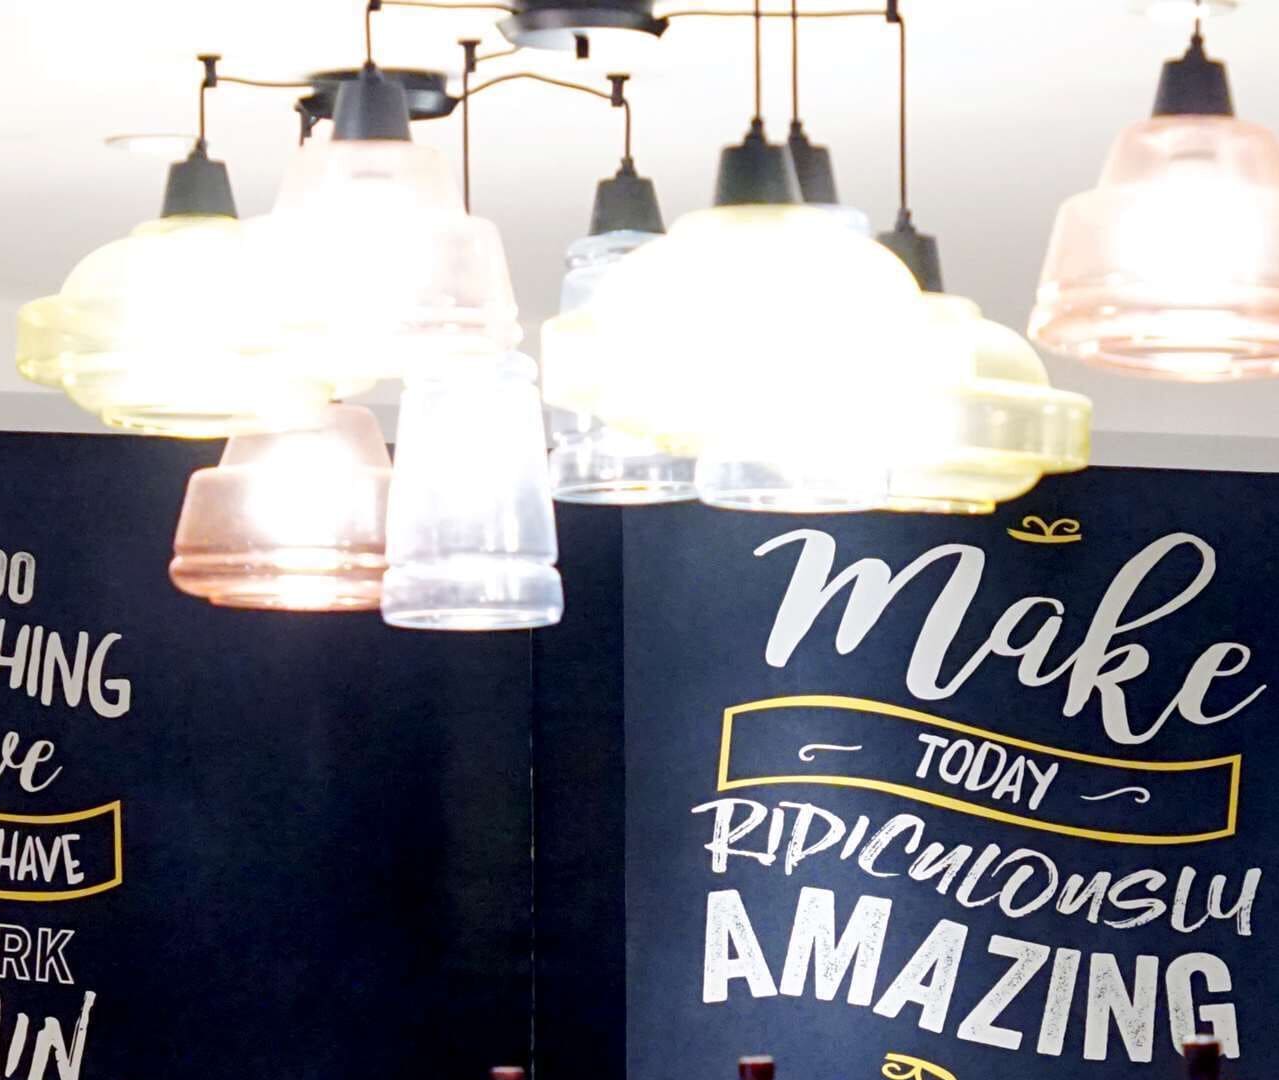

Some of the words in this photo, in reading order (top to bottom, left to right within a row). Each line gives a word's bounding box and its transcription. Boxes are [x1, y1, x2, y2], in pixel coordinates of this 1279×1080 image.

[753, 528, 1267, 744] Make
[915, 733, 1059, 810] TODAY
[702, 886, 1241, 1063] AMAZING
